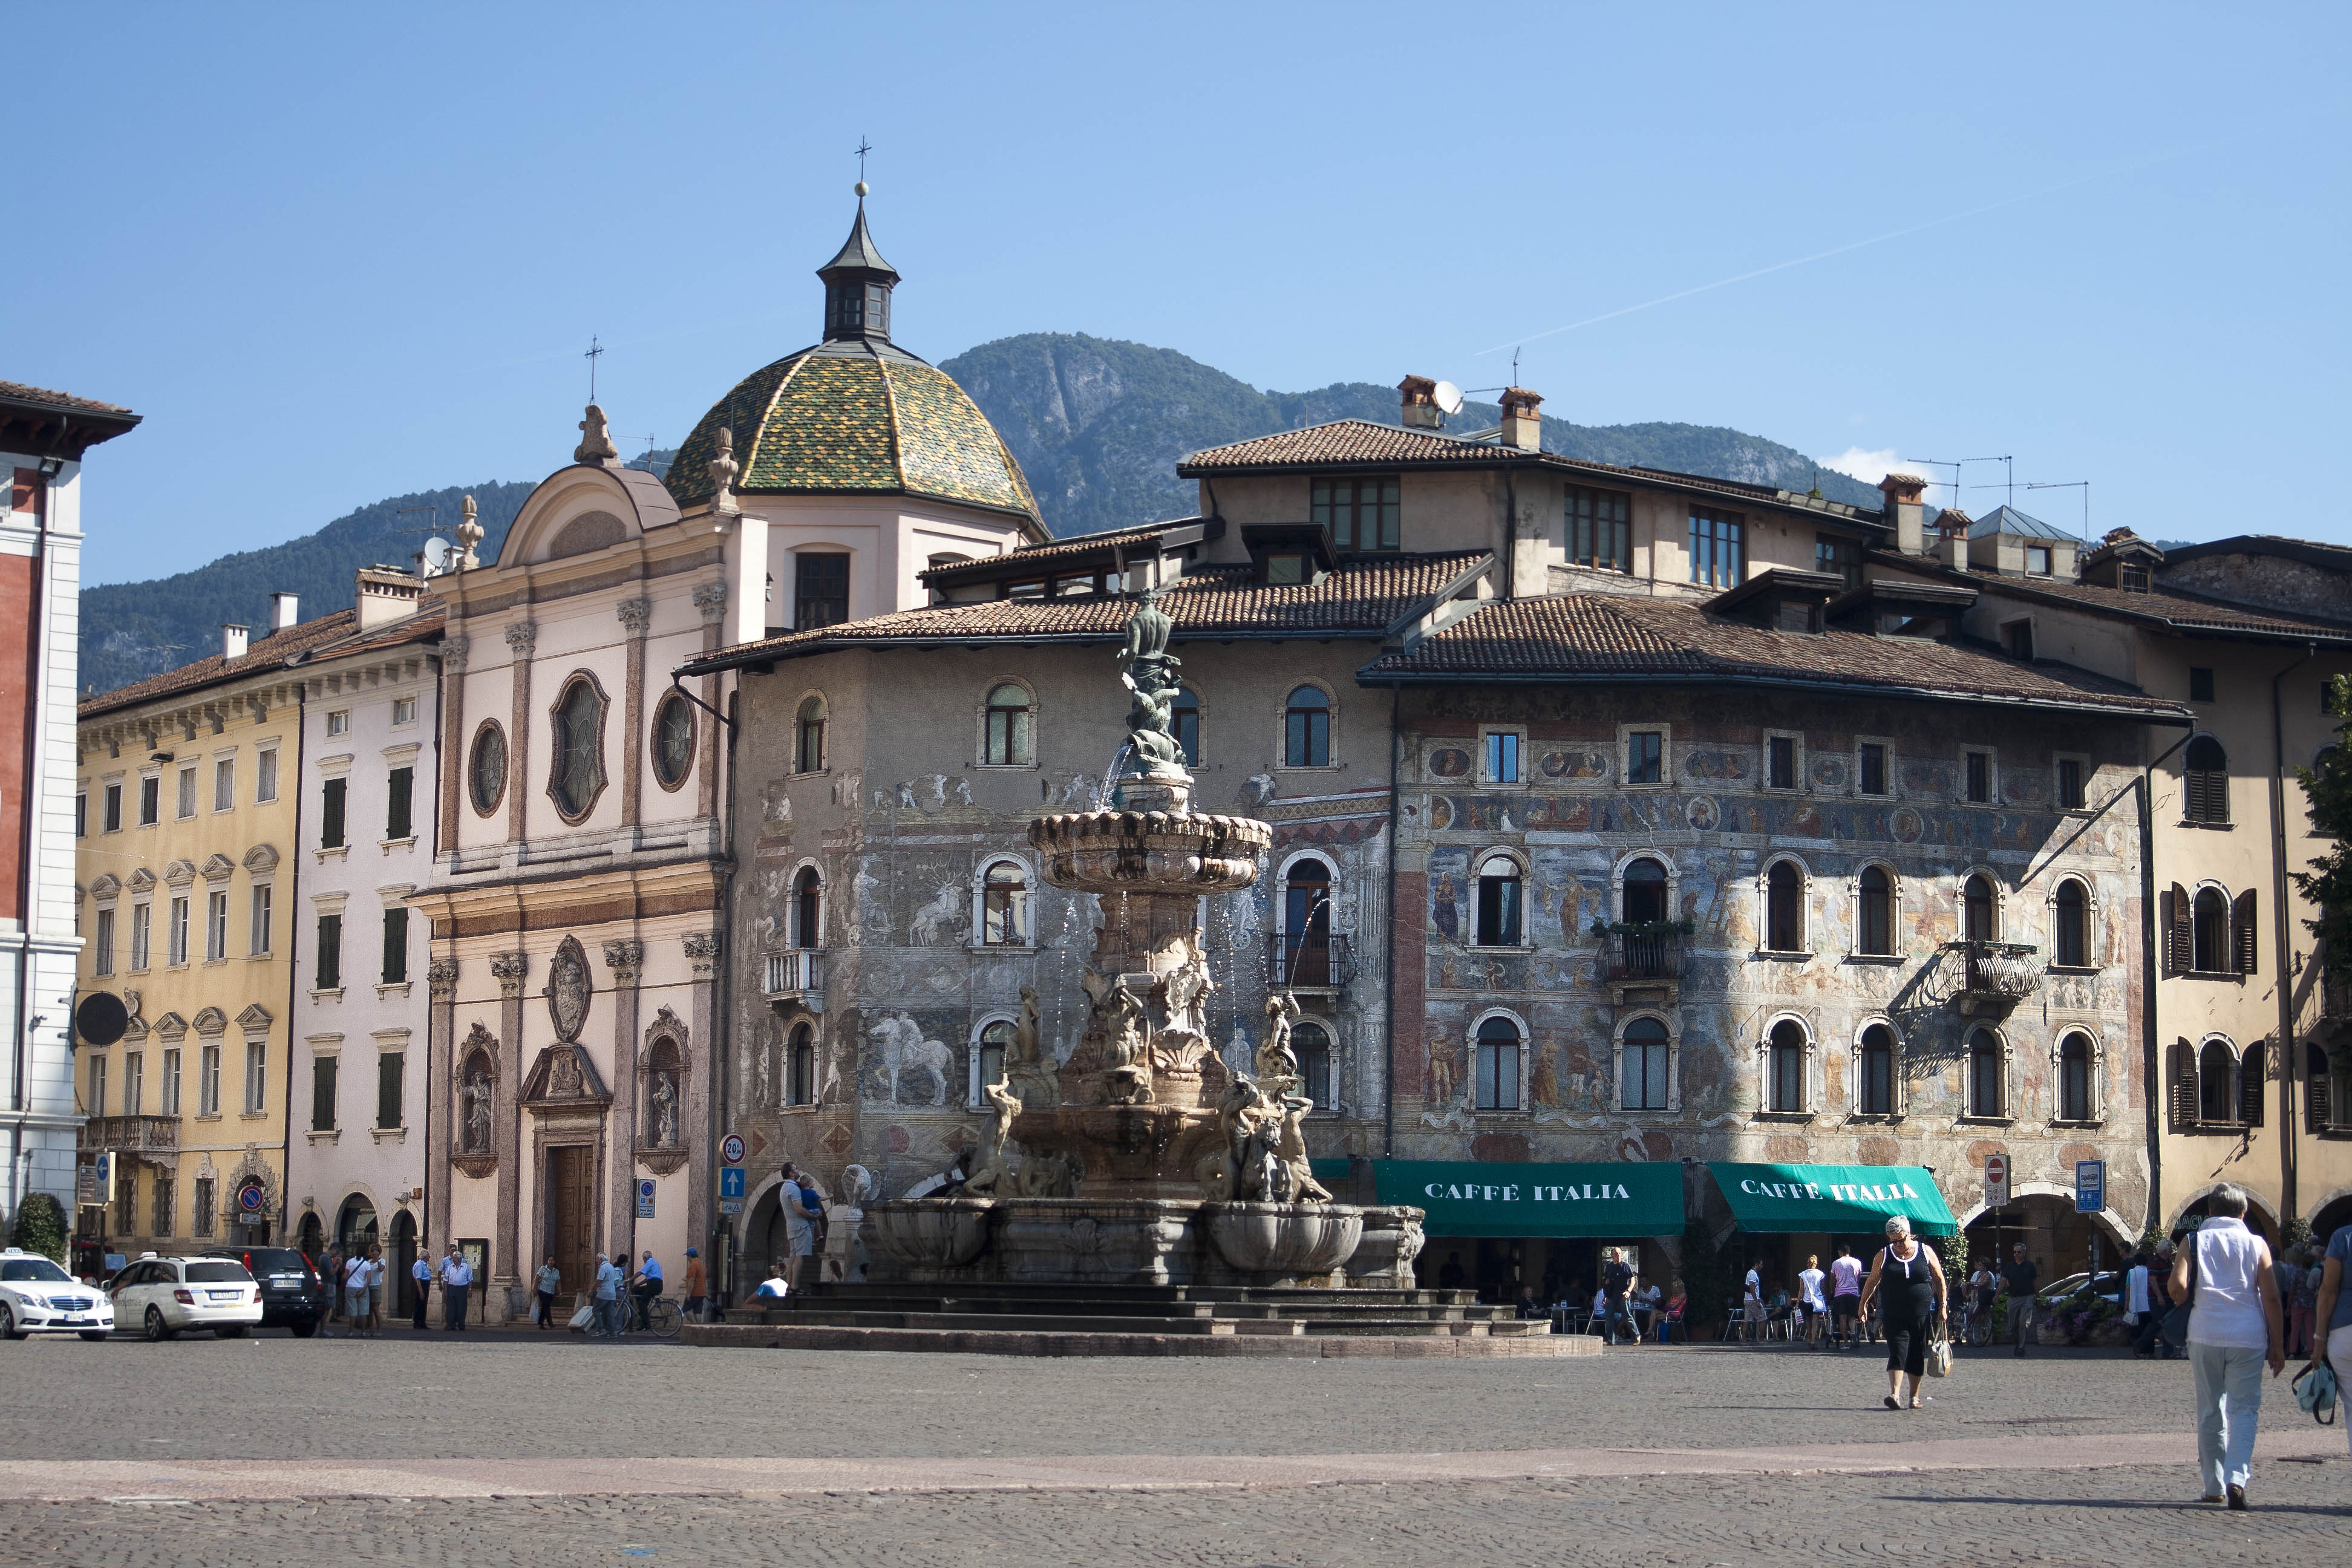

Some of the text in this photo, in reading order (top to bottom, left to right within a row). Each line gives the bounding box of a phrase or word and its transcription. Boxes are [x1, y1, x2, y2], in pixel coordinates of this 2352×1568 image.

[1425, 1183, 1630, 1201] CAFFÈ ITALIA
[1741, 1179, 1919, 1201] CAFFÈ ITALIA
